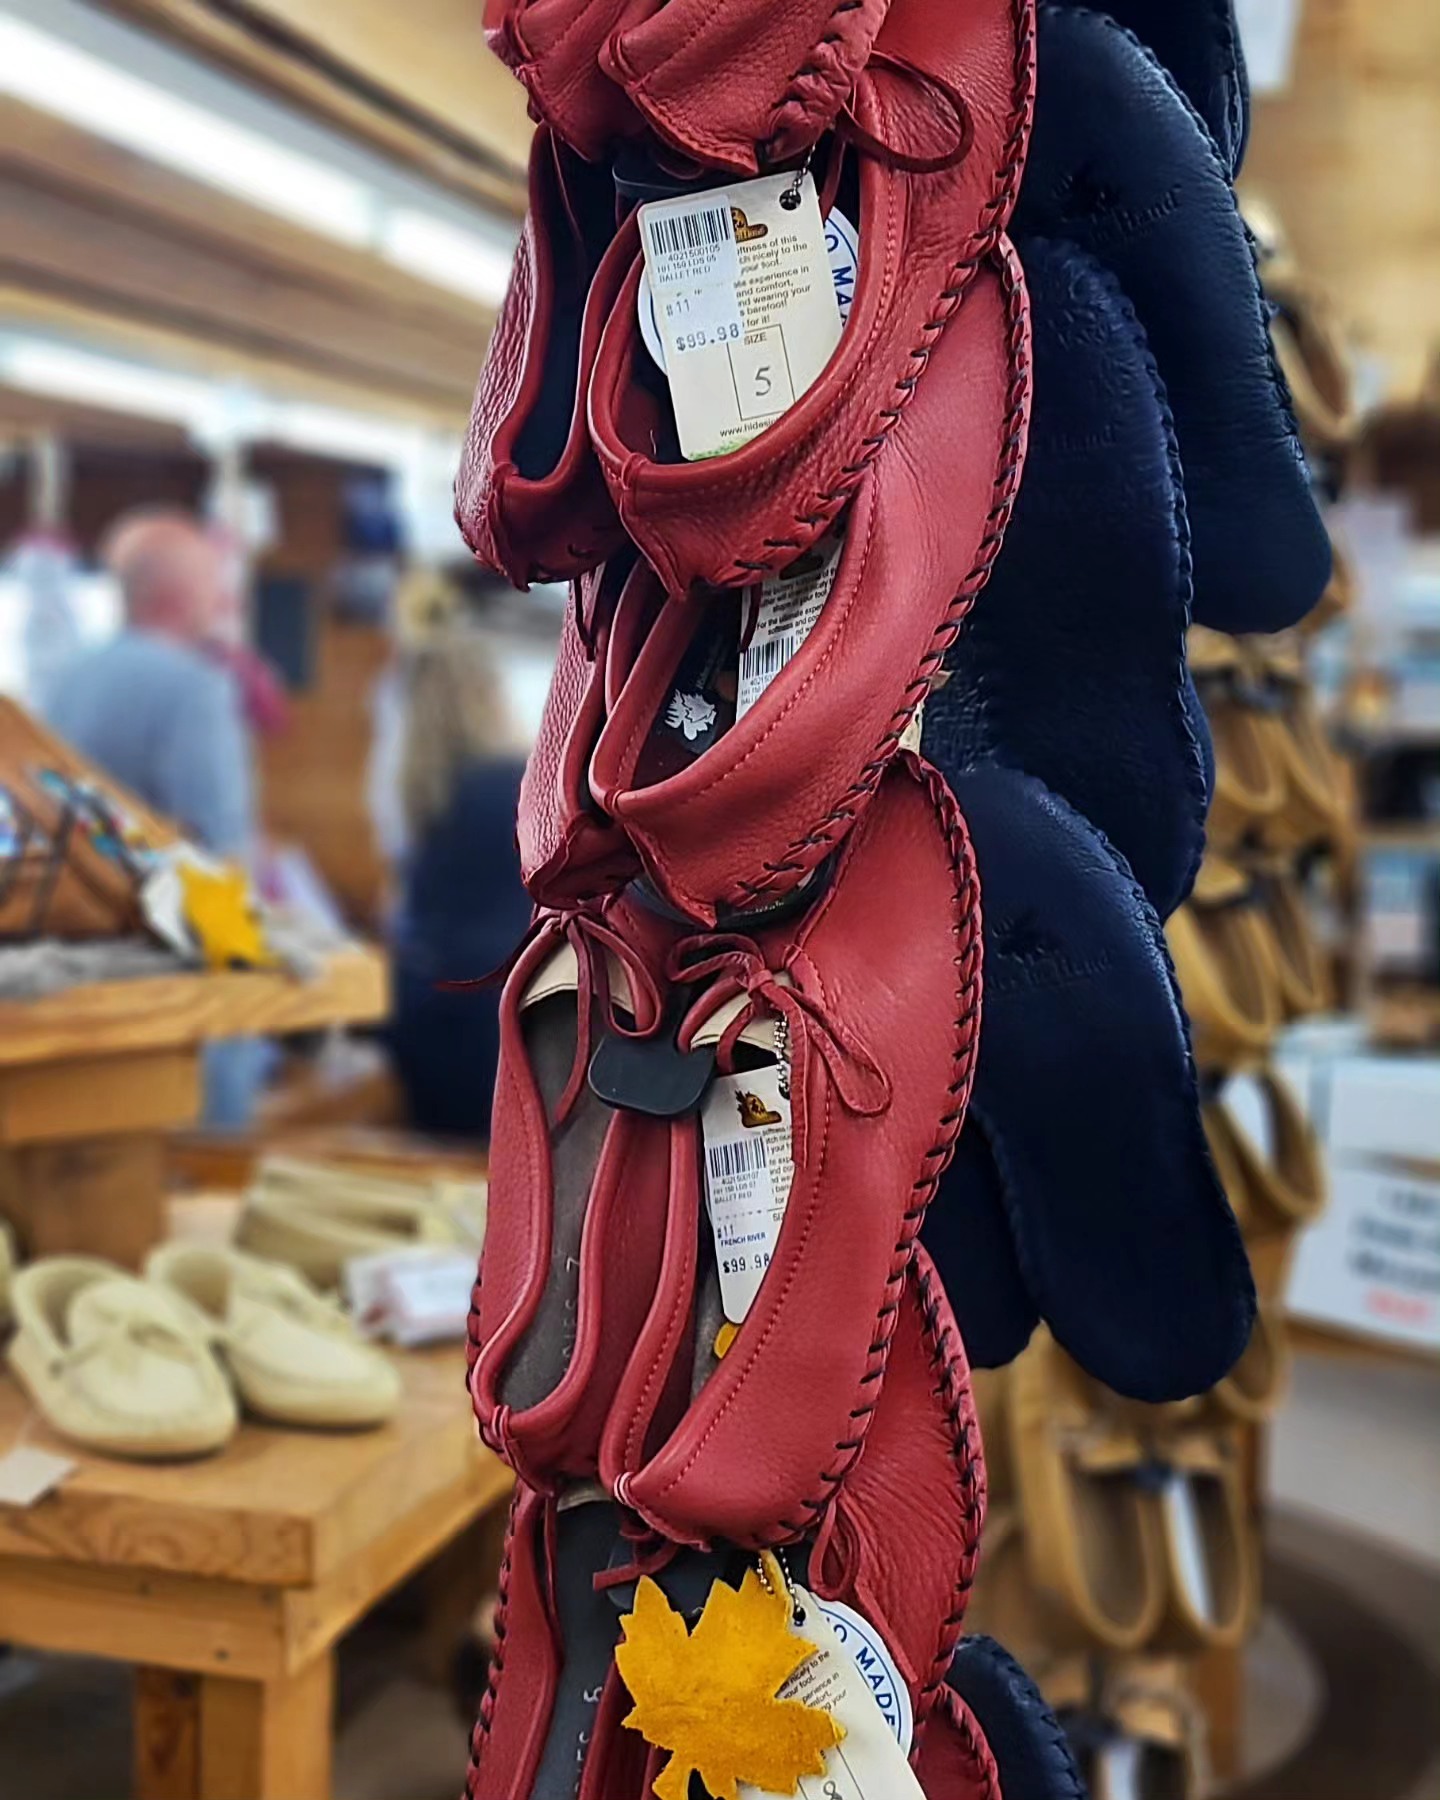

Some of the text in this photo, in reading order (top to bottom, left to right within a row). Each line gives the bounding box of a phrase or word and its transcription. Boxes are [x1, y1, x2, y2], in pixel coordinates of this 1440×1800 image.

[769, 238, 779, 247] of
[781, 235, 798, 245] this
[781, 246, 791, 254] to
[792, 243, 808, 252] the
[800, 265, 810, 273] in
[790, 285, 811, 298] your
[746, 319, 759, 328] for
[676, 323, 740, 351] $99.98
[743, 332, 767, 345] SIZE
[755, 364, 772, 397] 5
[768, 617, 778, 627] the
[794, 617, 807, 627] and
[775, 1196, 785, 1205] for
[720, 1231, 766, 1247] FRENCH RIVER
[809, 1659, 819, 1669] to
[817, 1650, 830, 1663] the
[831, 1671, 840, 1681] in
[831, 1688, 847, 1707] your
